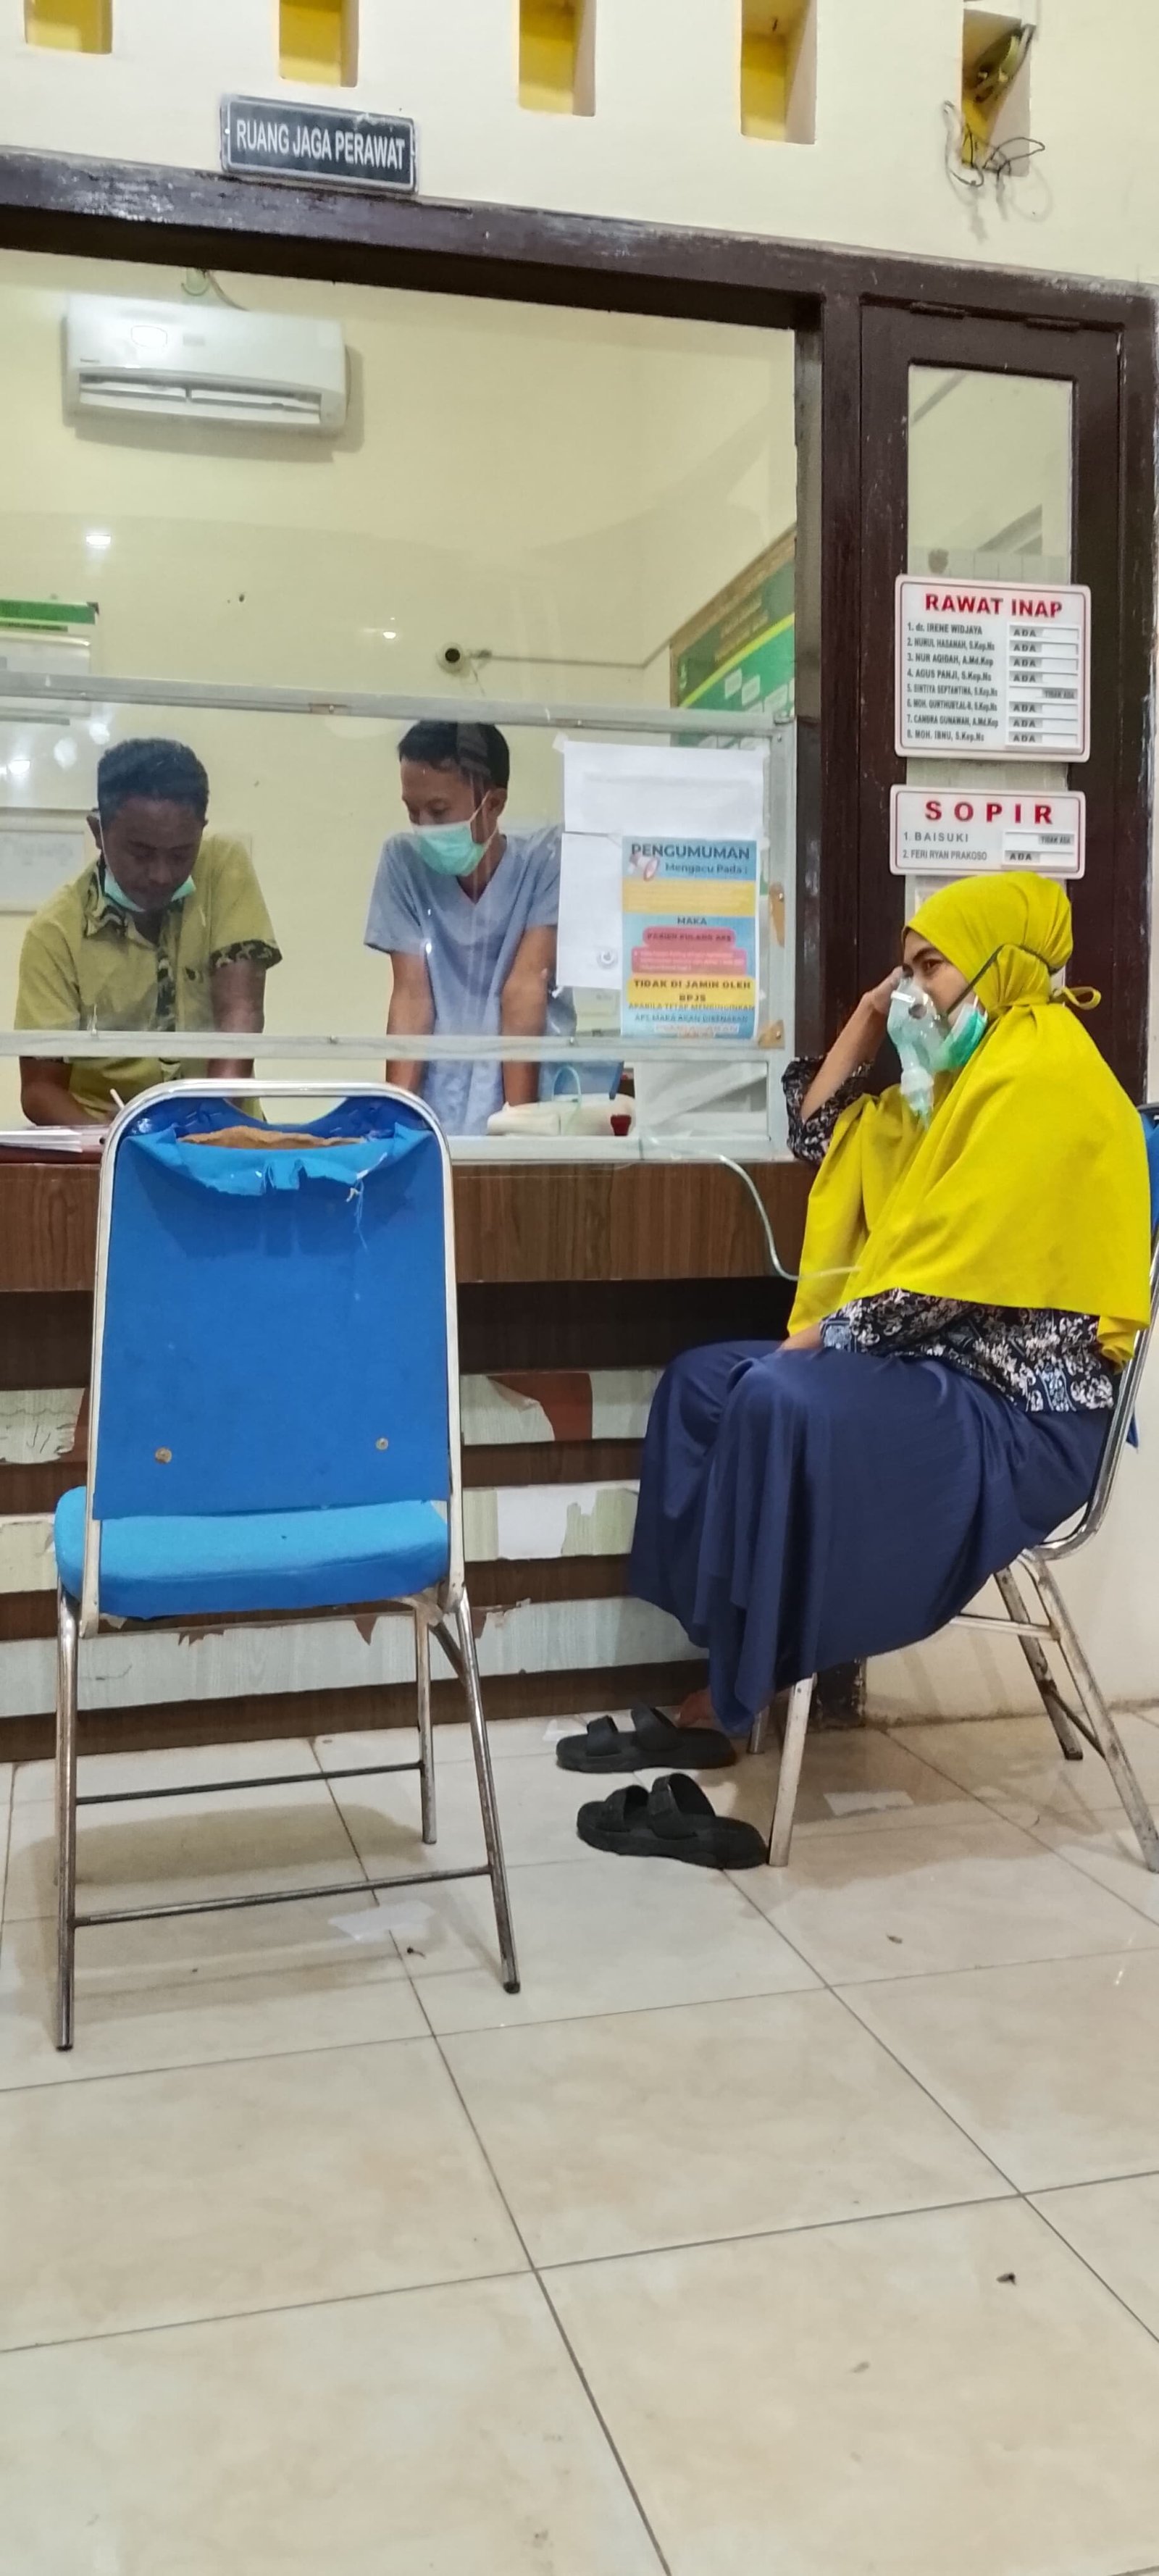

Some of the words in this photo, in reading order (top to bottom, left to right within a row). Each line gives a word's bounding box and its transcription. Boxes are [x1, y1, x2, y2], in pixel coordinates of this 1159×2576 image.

[237, 120, 289, 154] RUANG
[293, 126, 332, 161] JAGA
[335, 130, 406, 170] PERAWAT
[926, 593, 1003, 615] RAWAT
[1011, 598, 1063, 618] INAP
[908, 622, 914, 631] 1.
[916, 622, 925, 632] dr.
[927, 623, 949, 633] IRENE
[951, 624, 983, 635] WIDJAYA
[1013, 629, 1037, 637] ADA
[907, 637, 913, 646] 2.
[914, 638, 935, 648] NURUL
[907, 653, 913, 661] 3.
[915, 653, 931, 663] NUR
[1013, 658, 1036, 667] ADA
[907, 668, 913, 677] 4.
[915, 669, 935, 679] AGUS
[1013, 674, 1036, 683] ADA
[907, 683, 912, 693] 5.
[1013, 704, 1036, 713] ADA
[907, 714, 913, 723] 7.
[1013, 719, 1036, 728] ADA
[915, 729, 932, 739] MOH.
[1013, 735, 1035, 743] ADA
[925, 800, 1053, 824] SOPIR
[915, 832, 969, 842] BAISUKI
[632, 843, 750, 860] PENGUMUMAN
[903, 849, 909, 858] 2.
[911, 849, 928, 859] FERI
[929, 850, 949, 860] RYAN
[950, 850, 987, 861] PRAKOSO
[665, 863, 714, 874] Mengacu
[716, 864, 742, 874] Pada
[677, 917, 707, 926] MAKA
[634, 980, 667, 990] TIDAK
[671, 980, 682, 989] DI
[686, 980, 719, 990] JAMIN
[722, 981, 750, 990] OLEH
